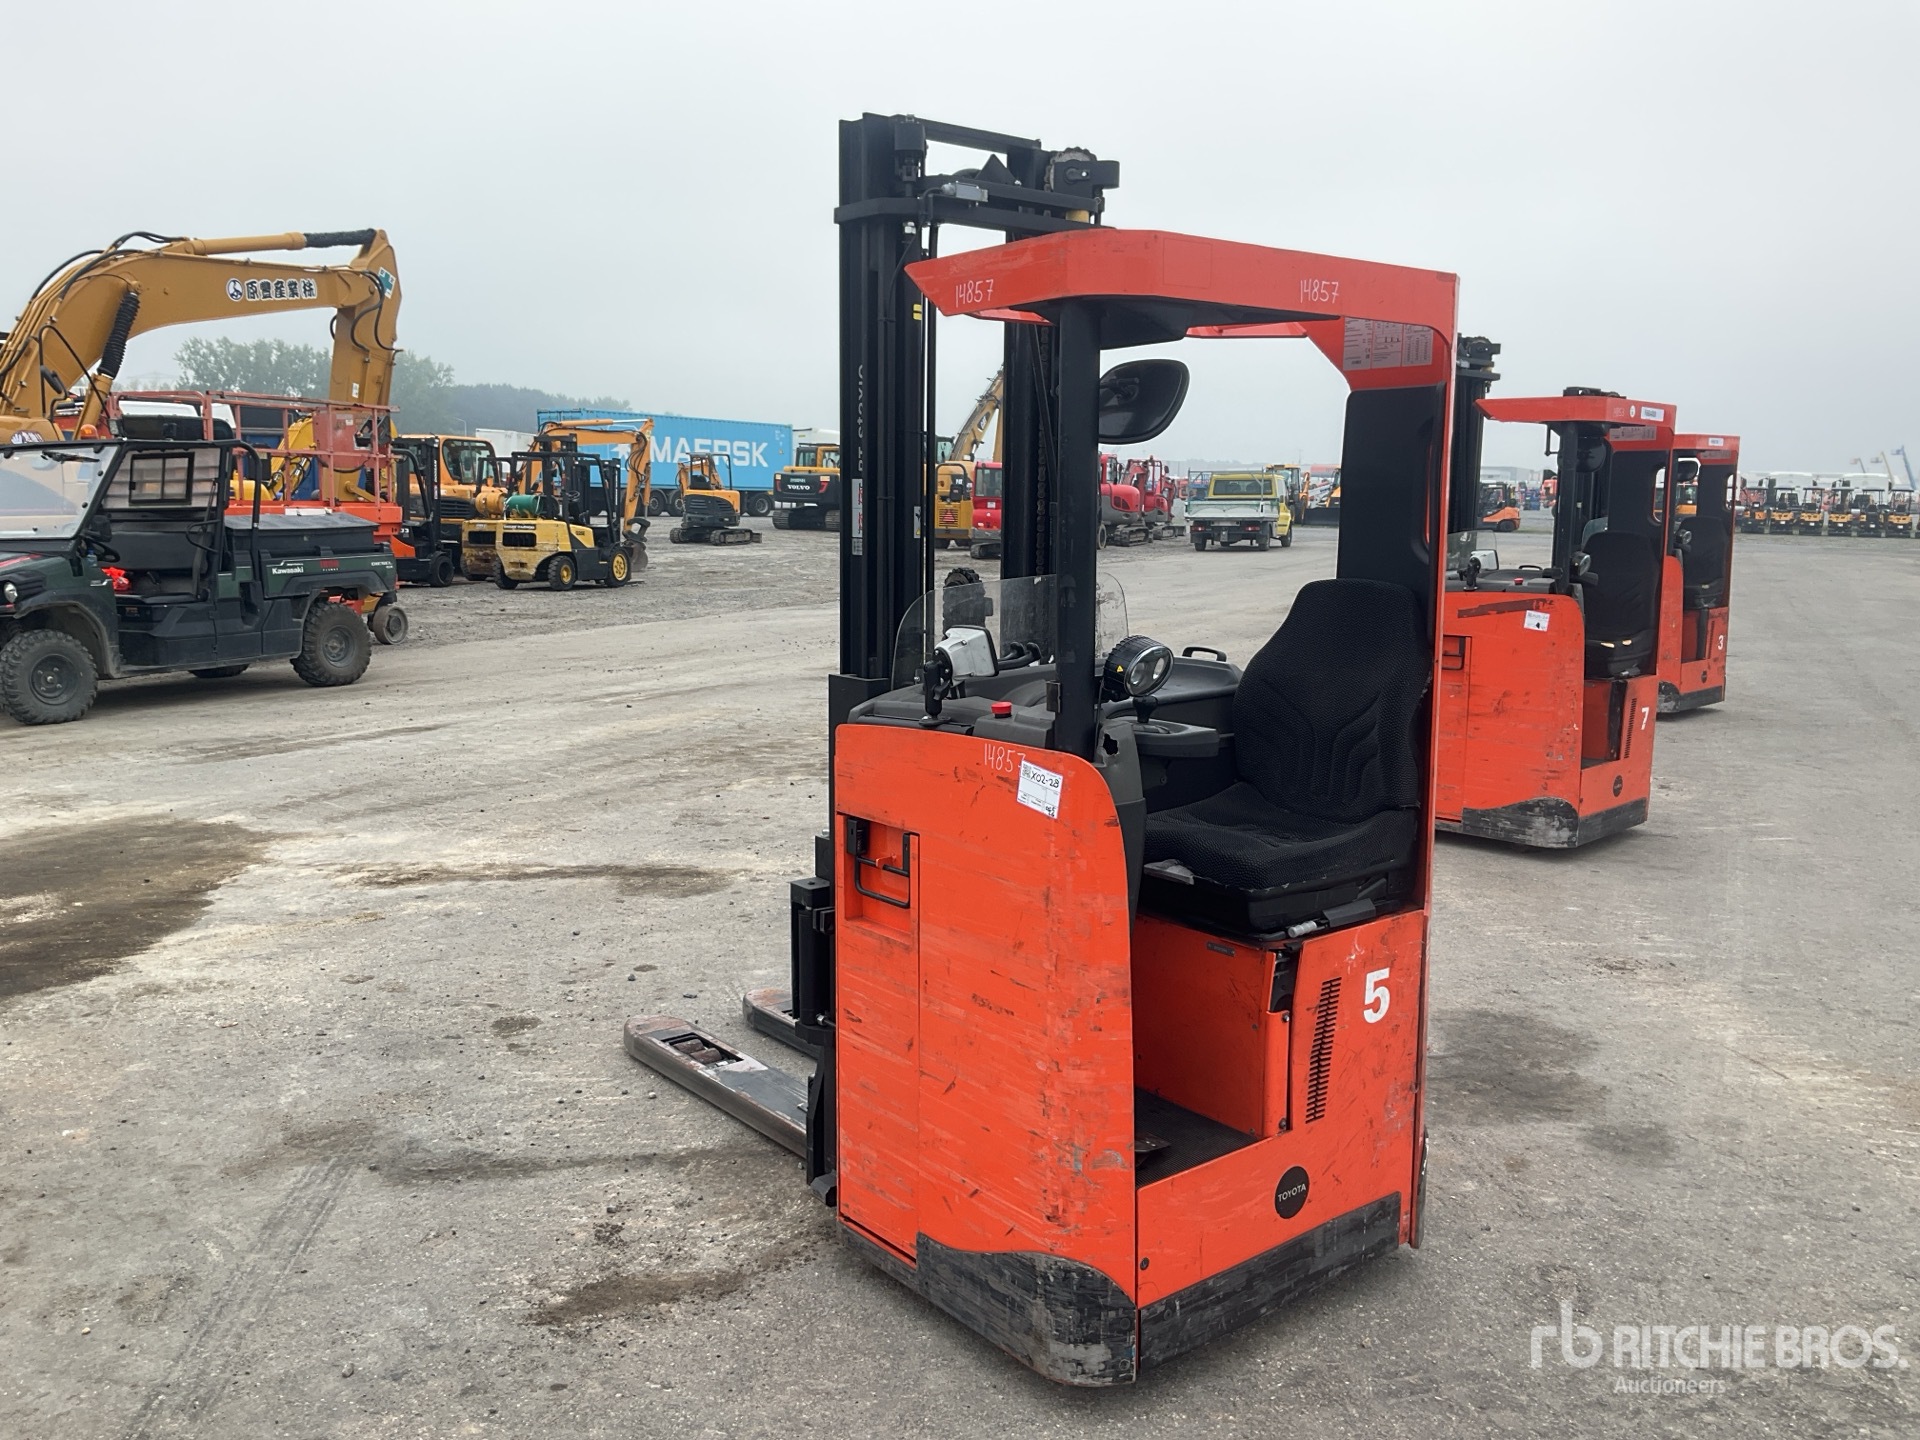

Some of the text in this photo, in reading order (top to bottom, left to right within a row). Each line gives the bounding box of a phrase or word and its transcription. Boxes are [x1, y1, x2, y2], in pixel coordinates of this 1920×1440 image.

[955, 279, 994, 308] 14857
[1300, 278, 1339, 304] 14857
[650, 435, 768, 467] MAERSK
[272, 566, 304, 575] Kawasaki
[1718, 635, 1724, 650] 3
[1641, 706, 1650, 730] 7
[1363, 967, 1391, 1024] 5
[1278, 1183, 1307, 1203] TOYOTA
